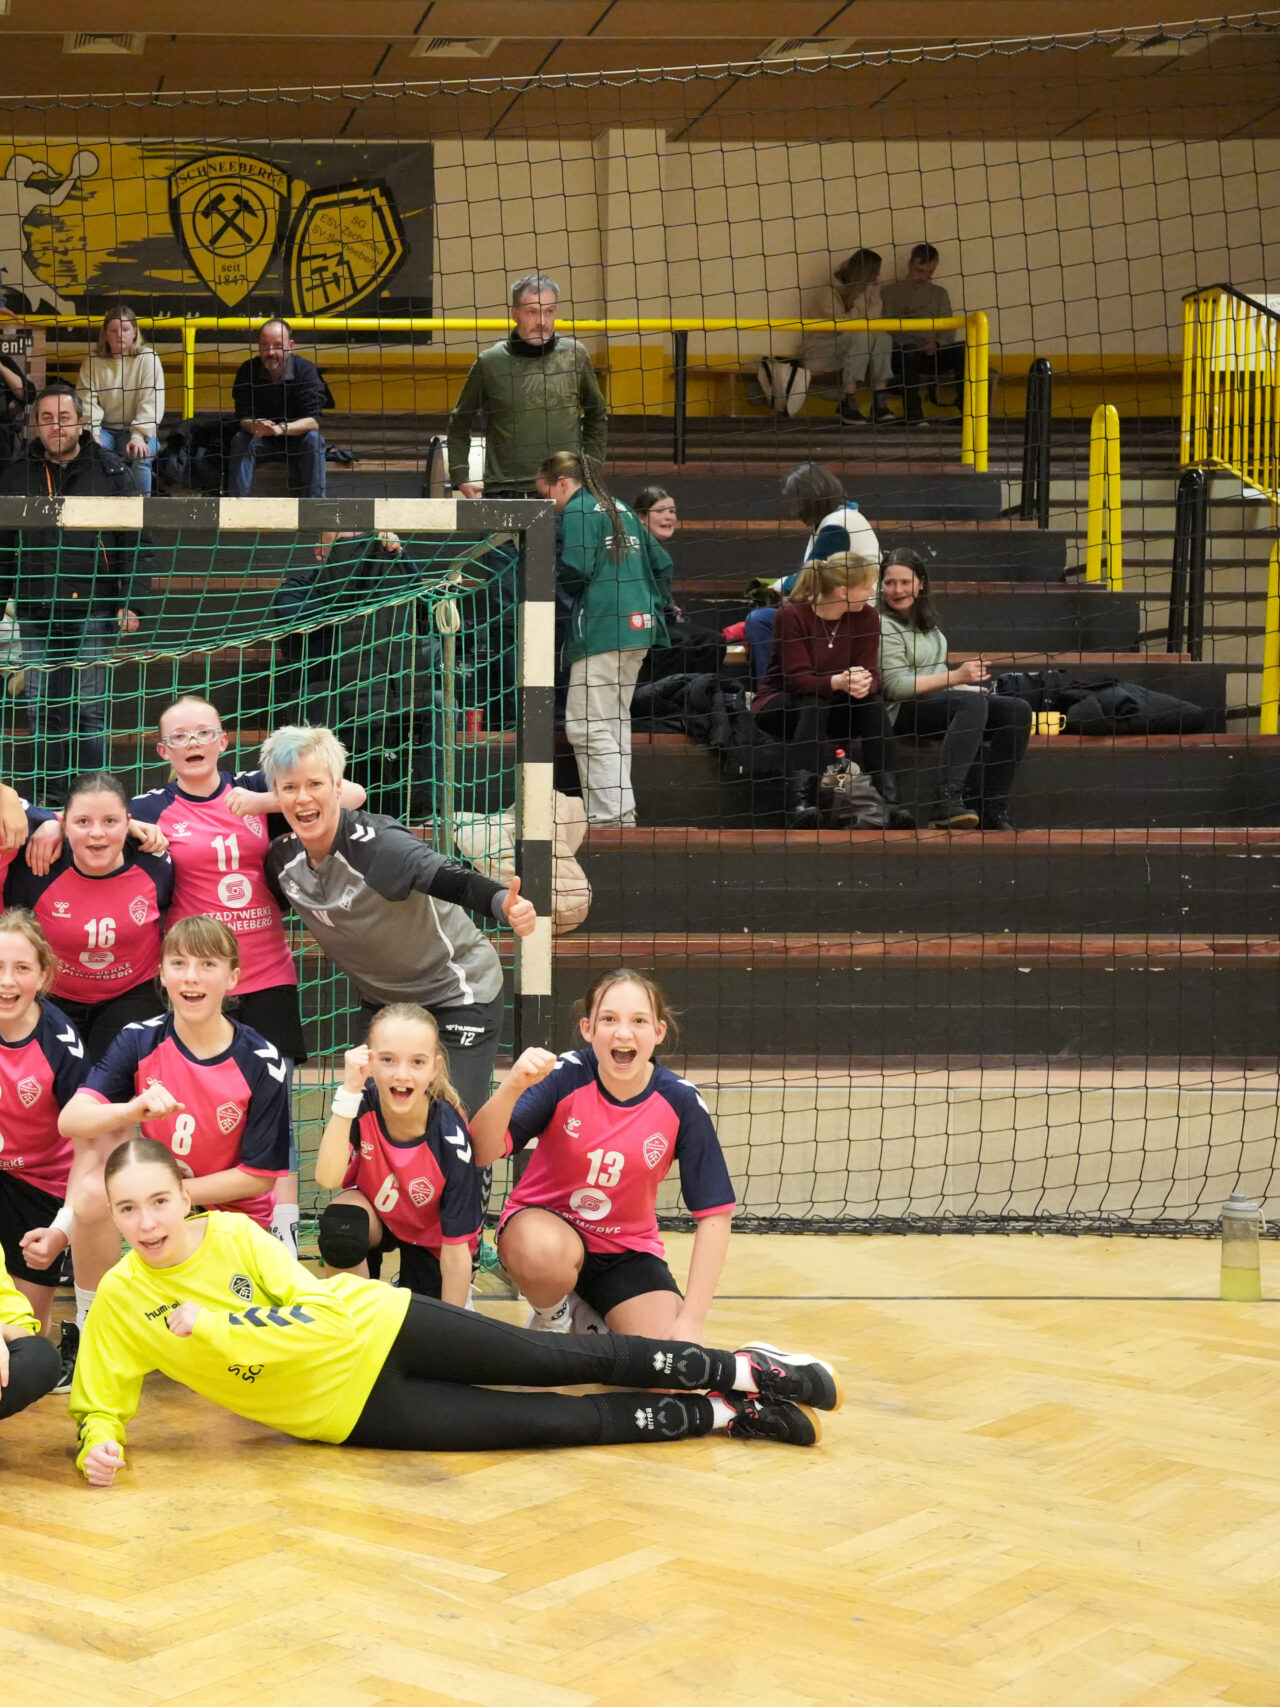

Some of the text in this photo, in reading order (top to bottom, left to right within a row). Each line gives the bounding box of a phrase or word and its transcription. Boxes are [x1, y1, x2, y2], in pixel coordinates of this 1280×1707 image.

[217, 275, 247, 286] 1847
[221, 262, 241, 272] seit
[210, 833, 240, 872] 11
[83, 917, 116, 948] 16
[228, 916, 272, 931] NEEBERG
[460, 1032, 476, 1046] 12
[171, 1113, 196, 1156] 8
[586, 1148, 625, 1188] 13
[374, 1173, 399, 1213] 6
